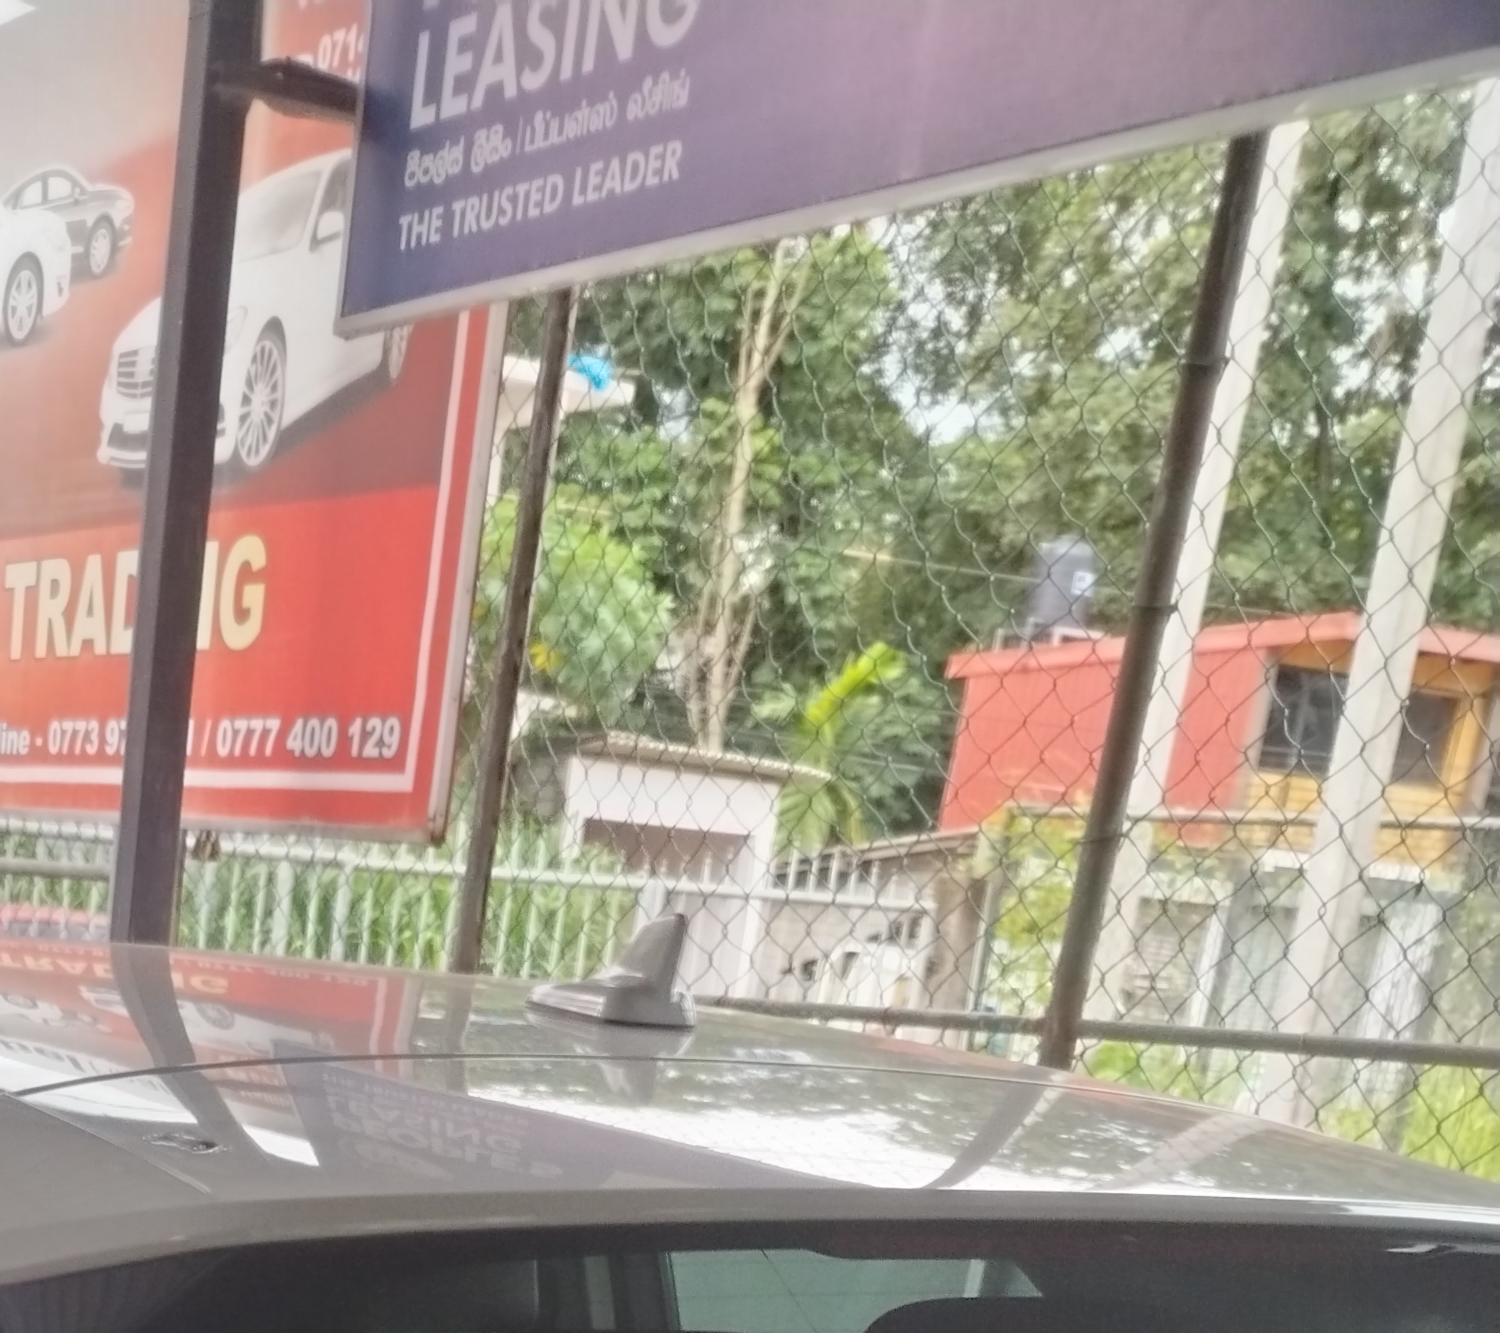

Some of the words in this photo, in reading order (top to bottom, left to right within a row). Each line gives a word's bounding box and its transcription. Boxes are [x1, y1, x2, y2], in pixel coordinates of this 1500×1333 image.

[410, 0, 701, 131] LEASING
[400, 206, 442, 250] THE
[452, 174, 563, 238] TRUSTED
[572, 140, 683, 208] LEADER
[5, 535, 268, 661] TRADG
[48, 719, 98, 756] 0773
[216, 717, 281, 758] 0777
[285, 716, 337, 758] 400
[348, 715, 400, 760] 129
